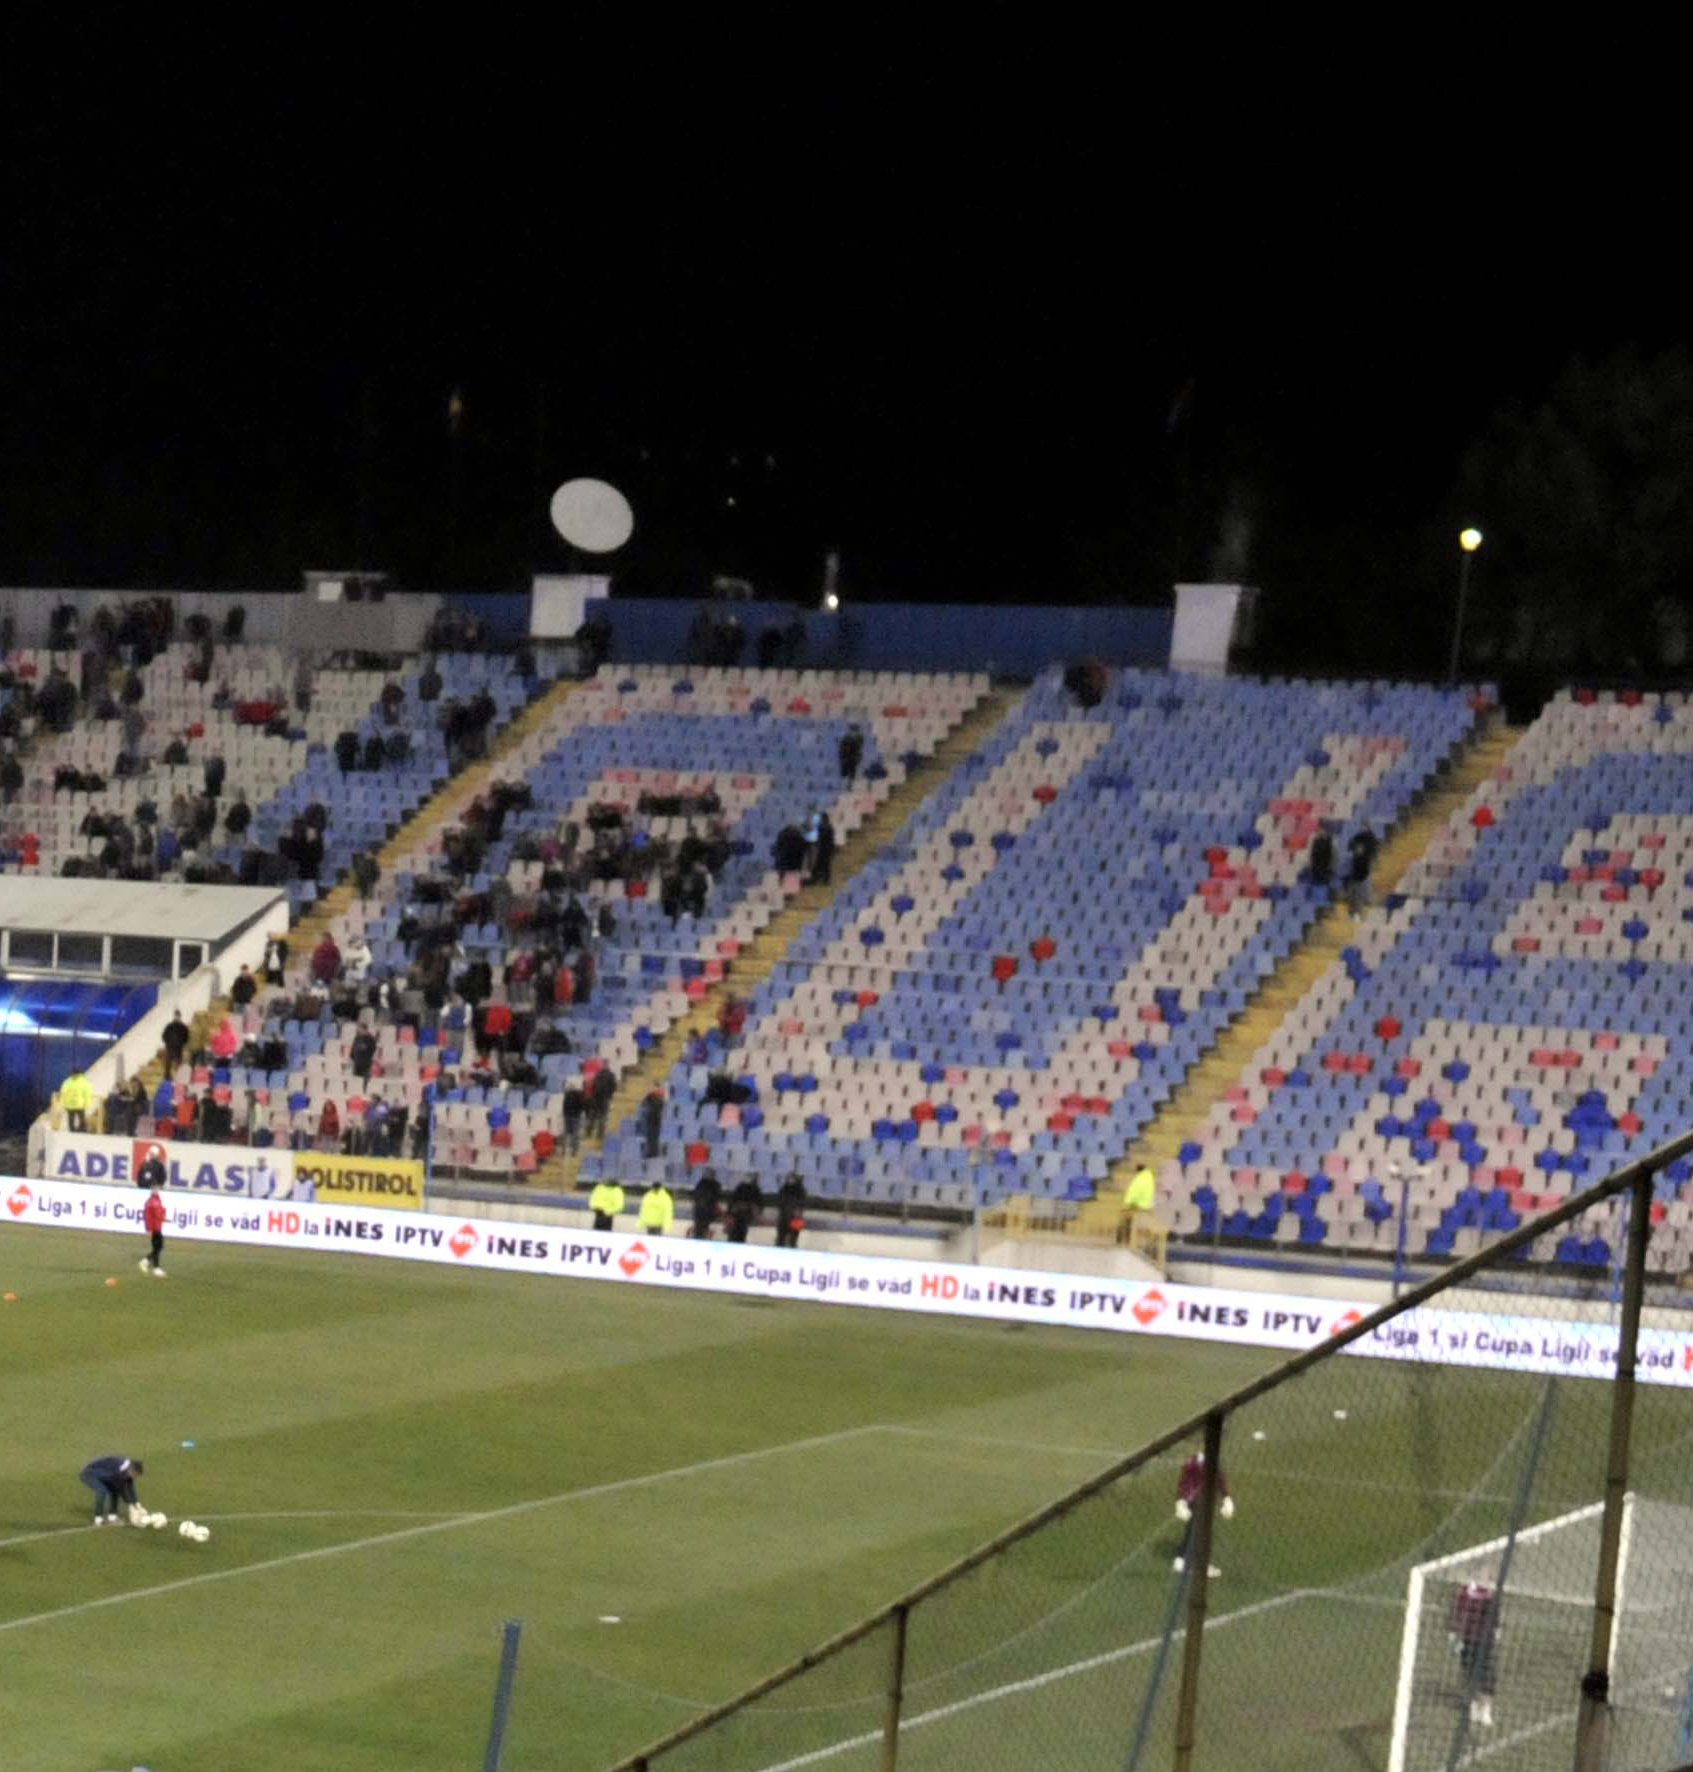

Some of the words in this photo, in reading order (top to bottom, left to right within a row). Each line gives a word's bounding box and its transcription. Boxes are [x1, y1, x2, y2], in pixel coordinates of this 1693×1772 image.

[57, 1139, 246, 1193] ADEPLAS
[295, 1165, 418, 1197] POLISTIROL
[38, 1196, 72, 1217] Liga
[114, 1203, 145, 1223] Cup
[165, 1206, 198, 1228] igii
[205, 1212, 223, 1227] se
[268, 1211, 299, 1234] HD
[395, 1225, 443, 1247] IPTV
[561, 1243, 611, 1265] IPTV
[655, 1254, 695, 1277] Liga
[743, 1262, 791, 1285] Cupa
[848, 1276, 869, 1290] se
[921, 1273, 959, 1300] HD
[1070, 1291, 1126, 1313] IPTV
[1263, 1312, 1321, 1334] IPTV
[1373, 1325, 1418, 1347] Liga
[1475, 1333, 1532, 1356] Cupa
